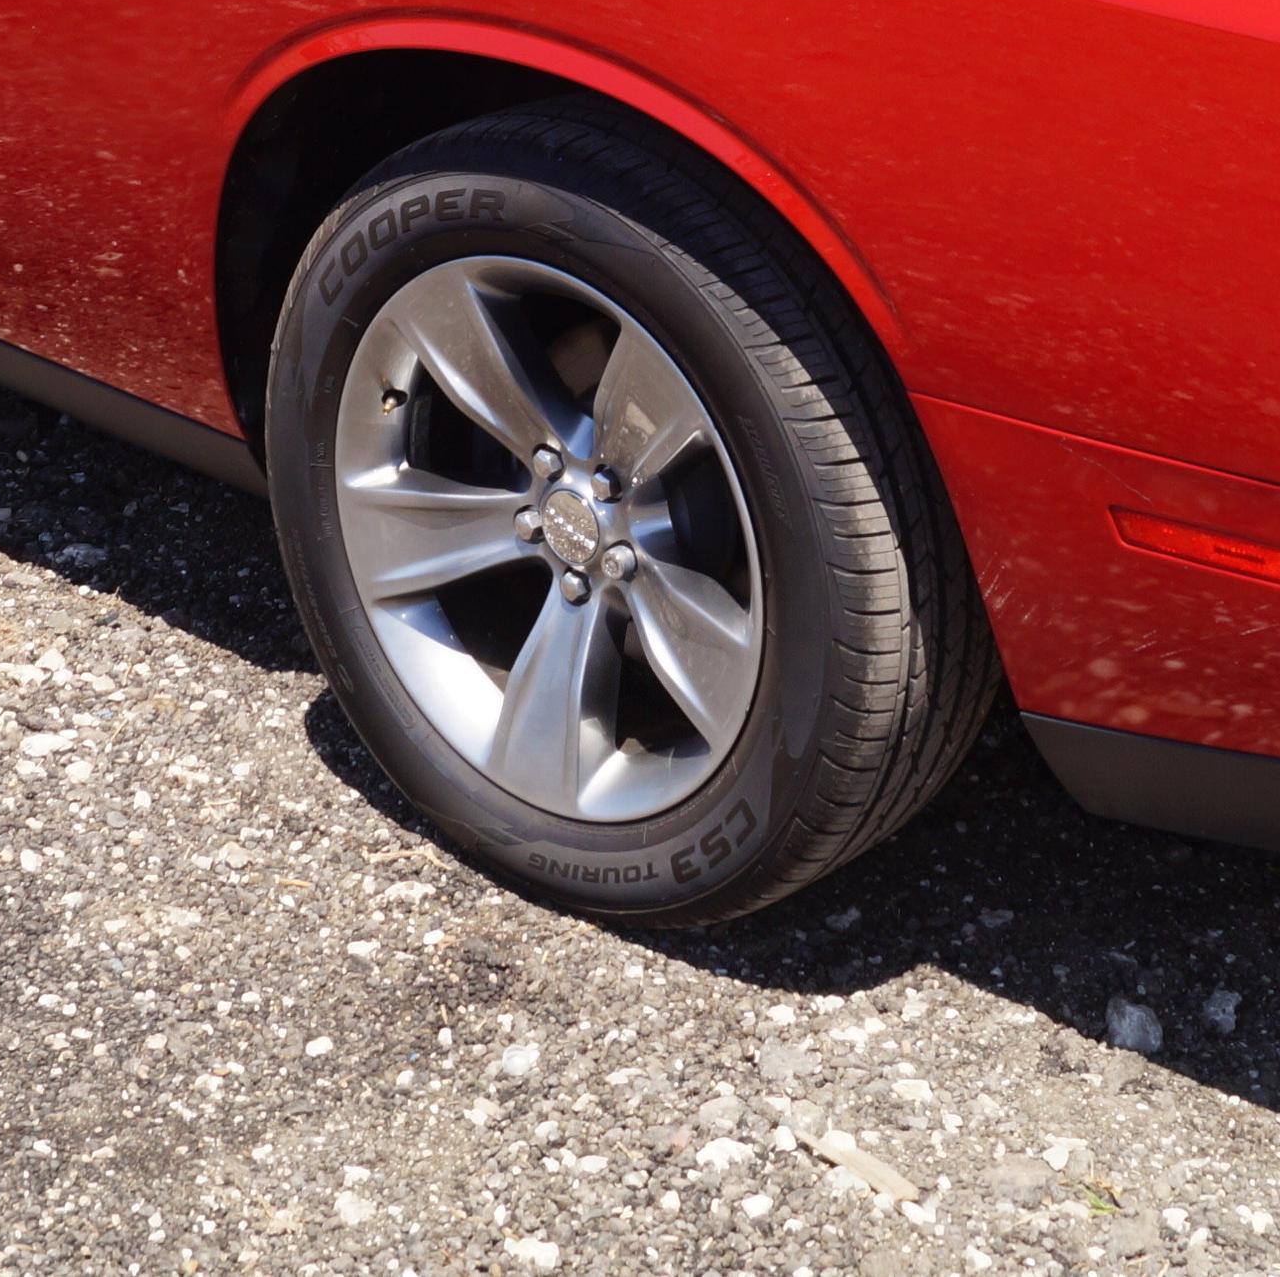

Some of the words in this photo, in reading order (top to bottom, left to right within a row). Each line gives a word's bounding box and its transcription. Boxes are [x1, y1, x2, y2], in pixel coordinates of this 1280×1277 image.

[317, 188, 507, 307] COOPER
[527, 851, 661, 885] TOURING
[670, 797, 758, 885] CS3
